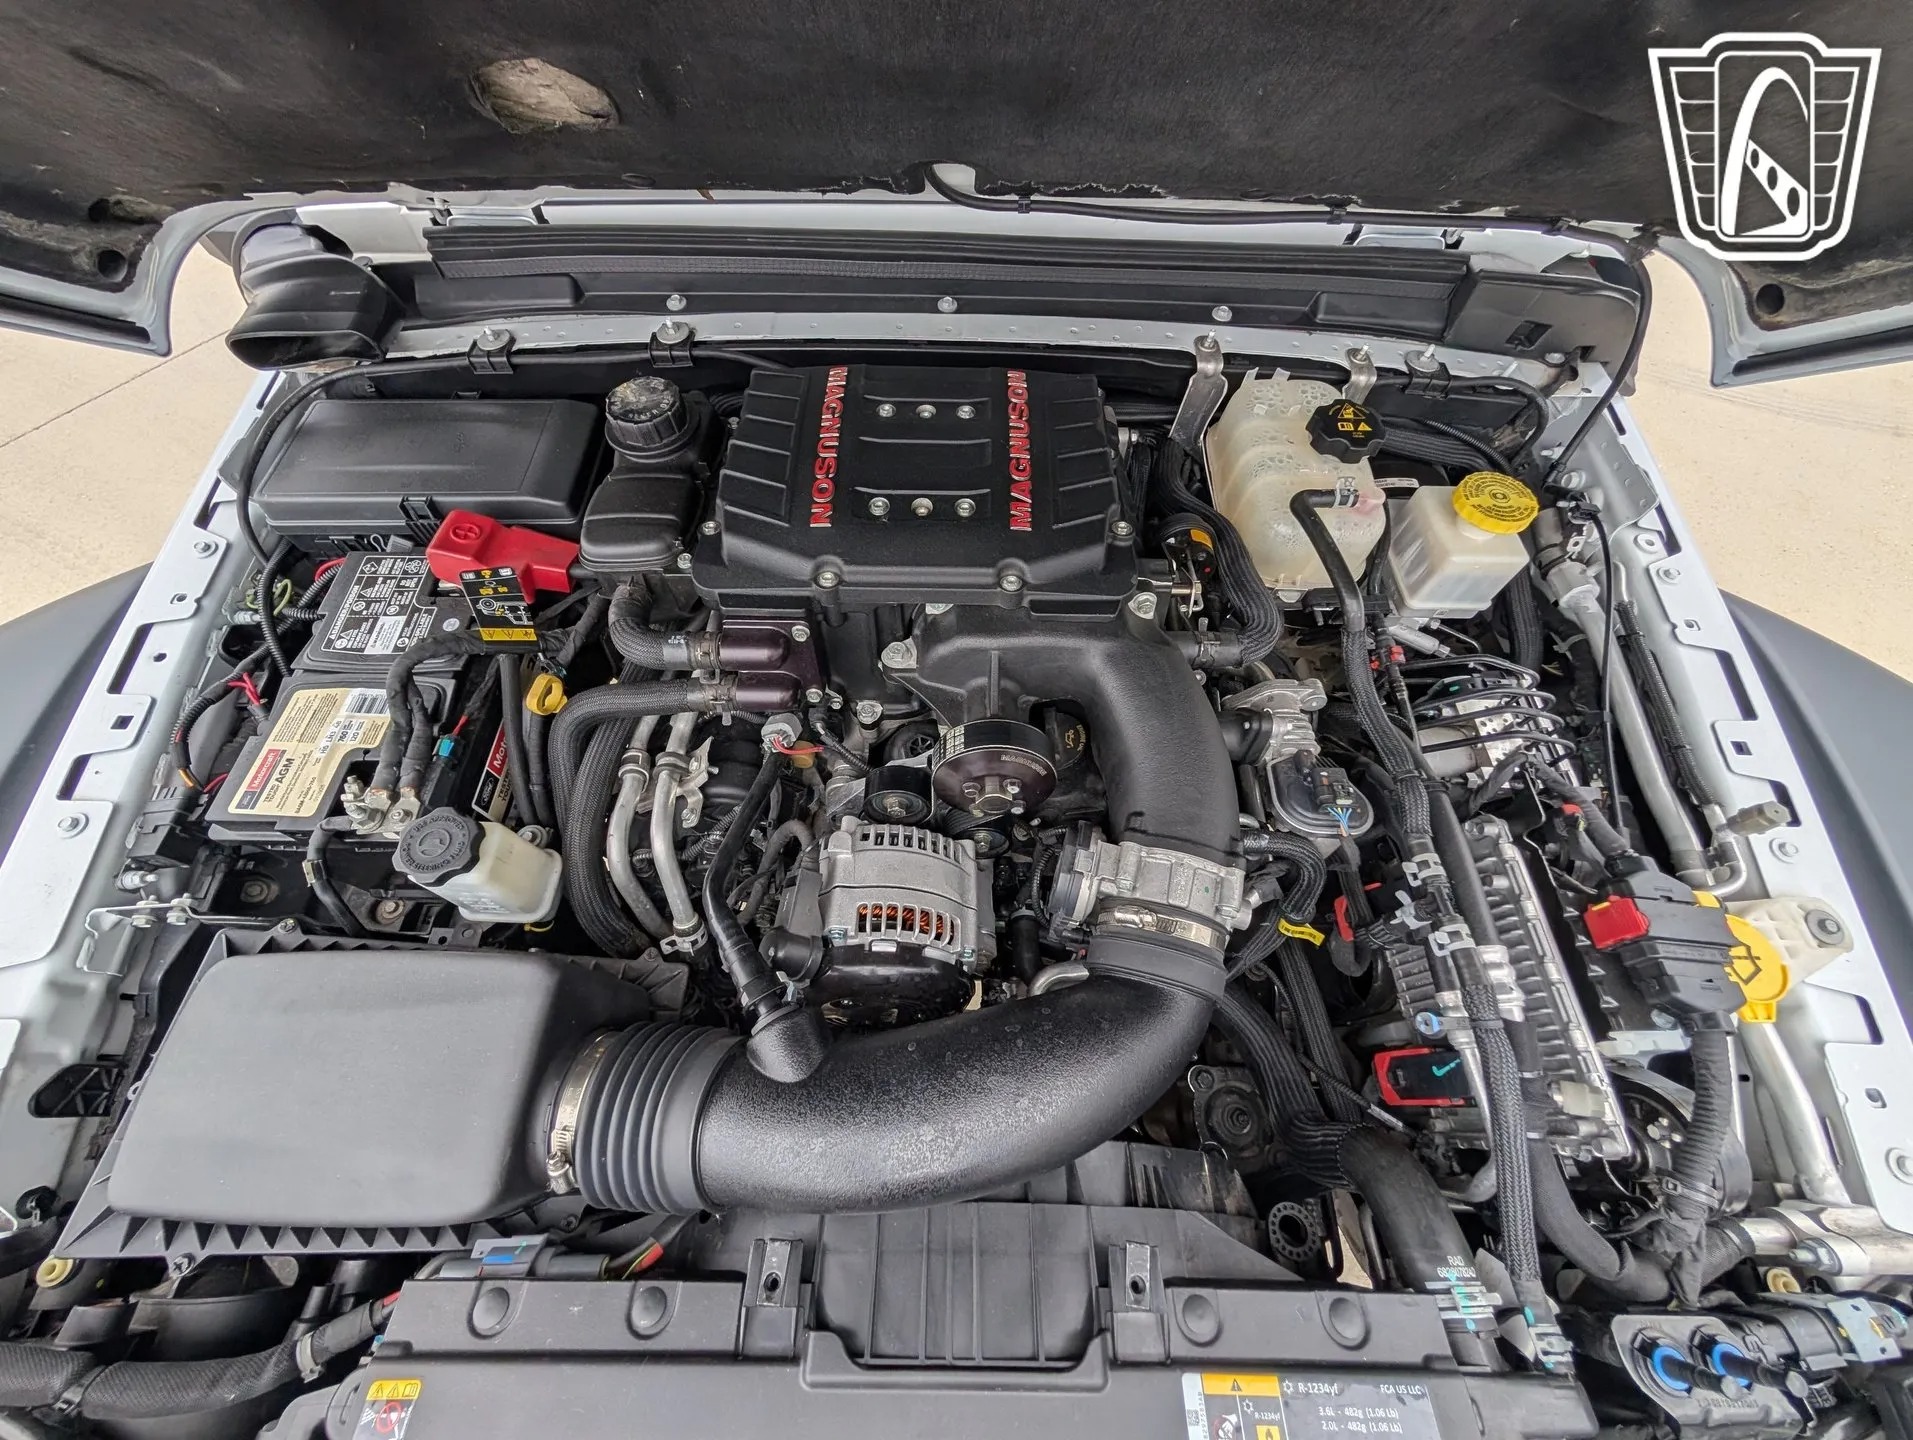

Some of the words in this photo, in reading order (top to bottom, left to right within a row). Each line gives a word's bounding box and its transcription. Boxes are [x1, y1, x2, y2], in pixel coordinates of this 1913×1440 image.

[809, 366, 849, 528] MAGNUSON
[1007, 369, 1033, 532] MAGNUSON
[337, 730, 349, 743] 760
[350, 731, 360, 742] 120
[251, 751, 277, 787] Motorcraft
[276, 757, 295, 784] AGM
[1446, 1255, 1465, 1267] RAD
[1298, 1382, 1339, 1396] R-1234yf
[1380, 1384, 1395, 1394] FCA
[1396, 1385, 1408, 1394] US
[1407, 1385, 1422, 1395] LLC
[1254, 1411, 1281, 1421] R-1234yf
[1318, 1406, 1335, 1416] 3.6L
[1344, 1407, 1364, 1419] 482g
[1365, 1407, 1385, 1419] (1.06
[1386, 1407, 1399, 1419] Lb)
[1321, 1420, 1339, 1431] 2.0L
[1347, 1421, 1367, 1433] 482g
[1368, 1422, 1388, 1433] (1.06
[1389, 1422, 1403, 1434] Lb)
